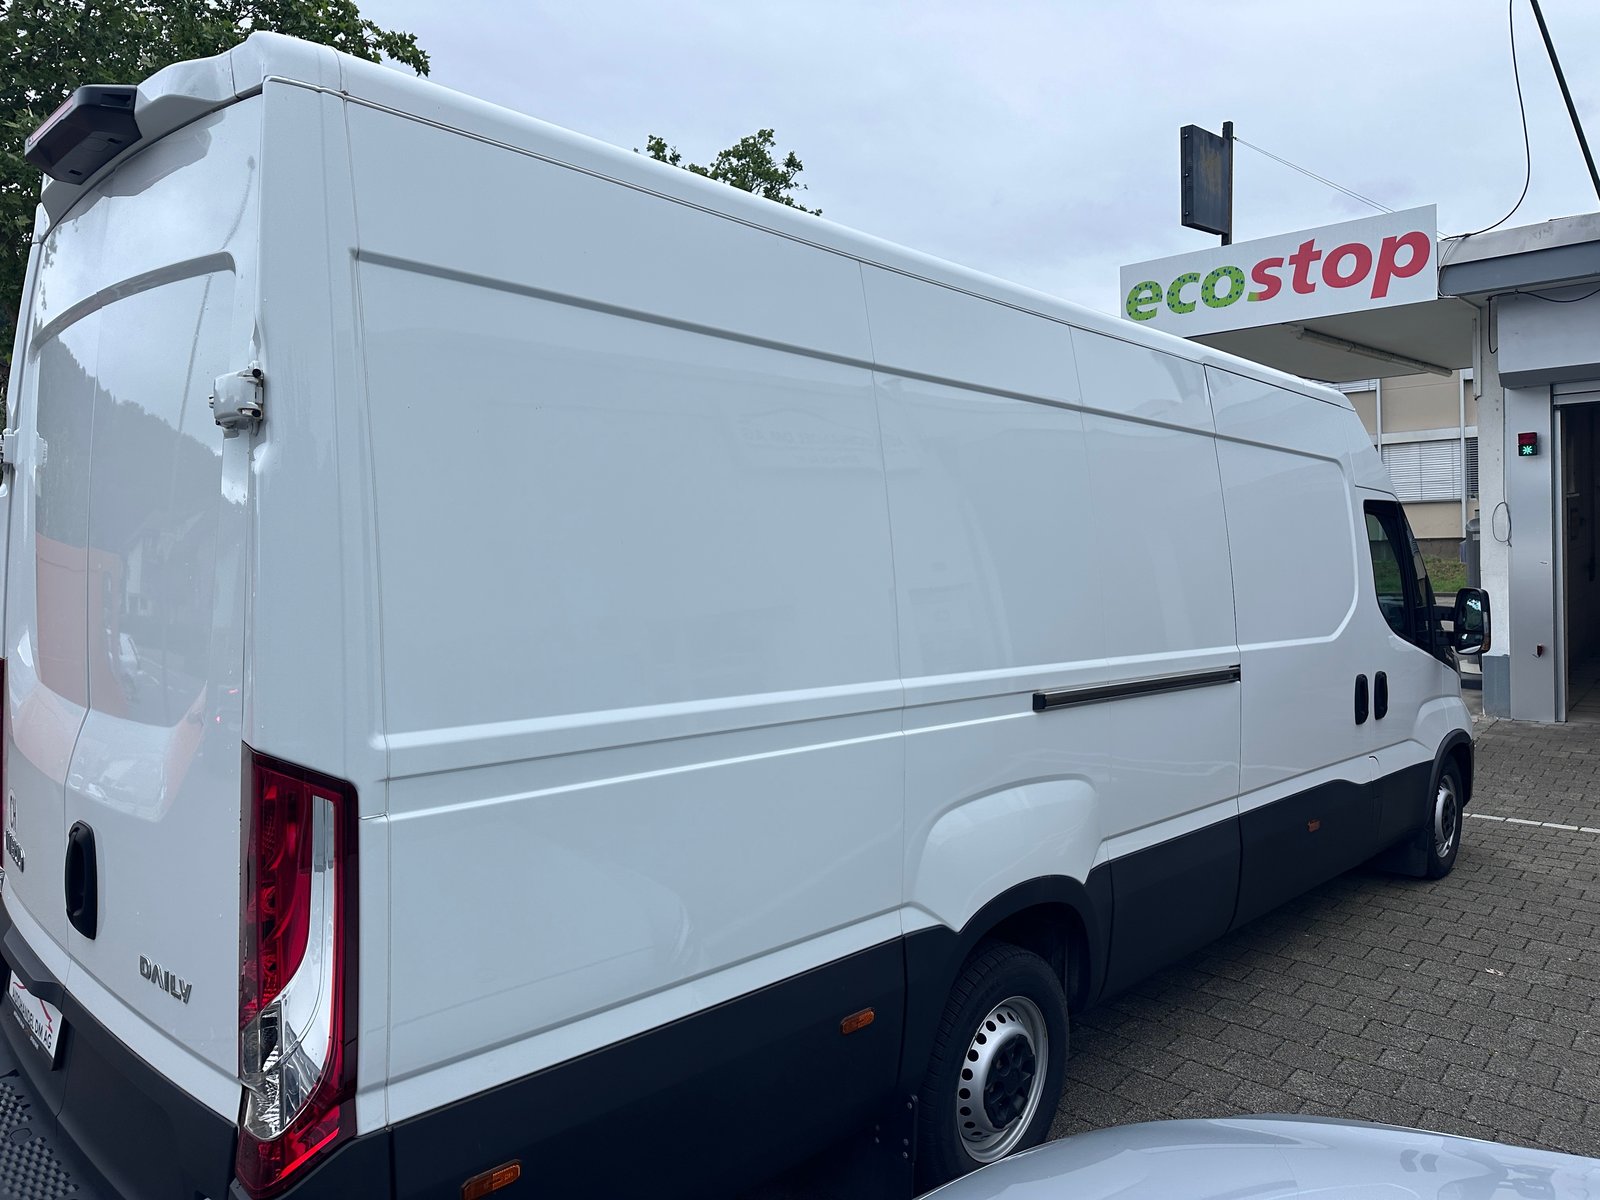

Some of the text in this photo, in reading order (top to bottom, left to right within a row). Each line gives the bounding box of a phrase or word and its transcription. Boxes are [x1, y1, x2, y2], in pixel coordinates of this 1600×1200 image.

[1125, 231, 1431, 321] ecostop
[139, 954, 192, 1004] DAILY
[34, 1018, 44, 1039] DM
[43, 1029, 52, 1049] AG
